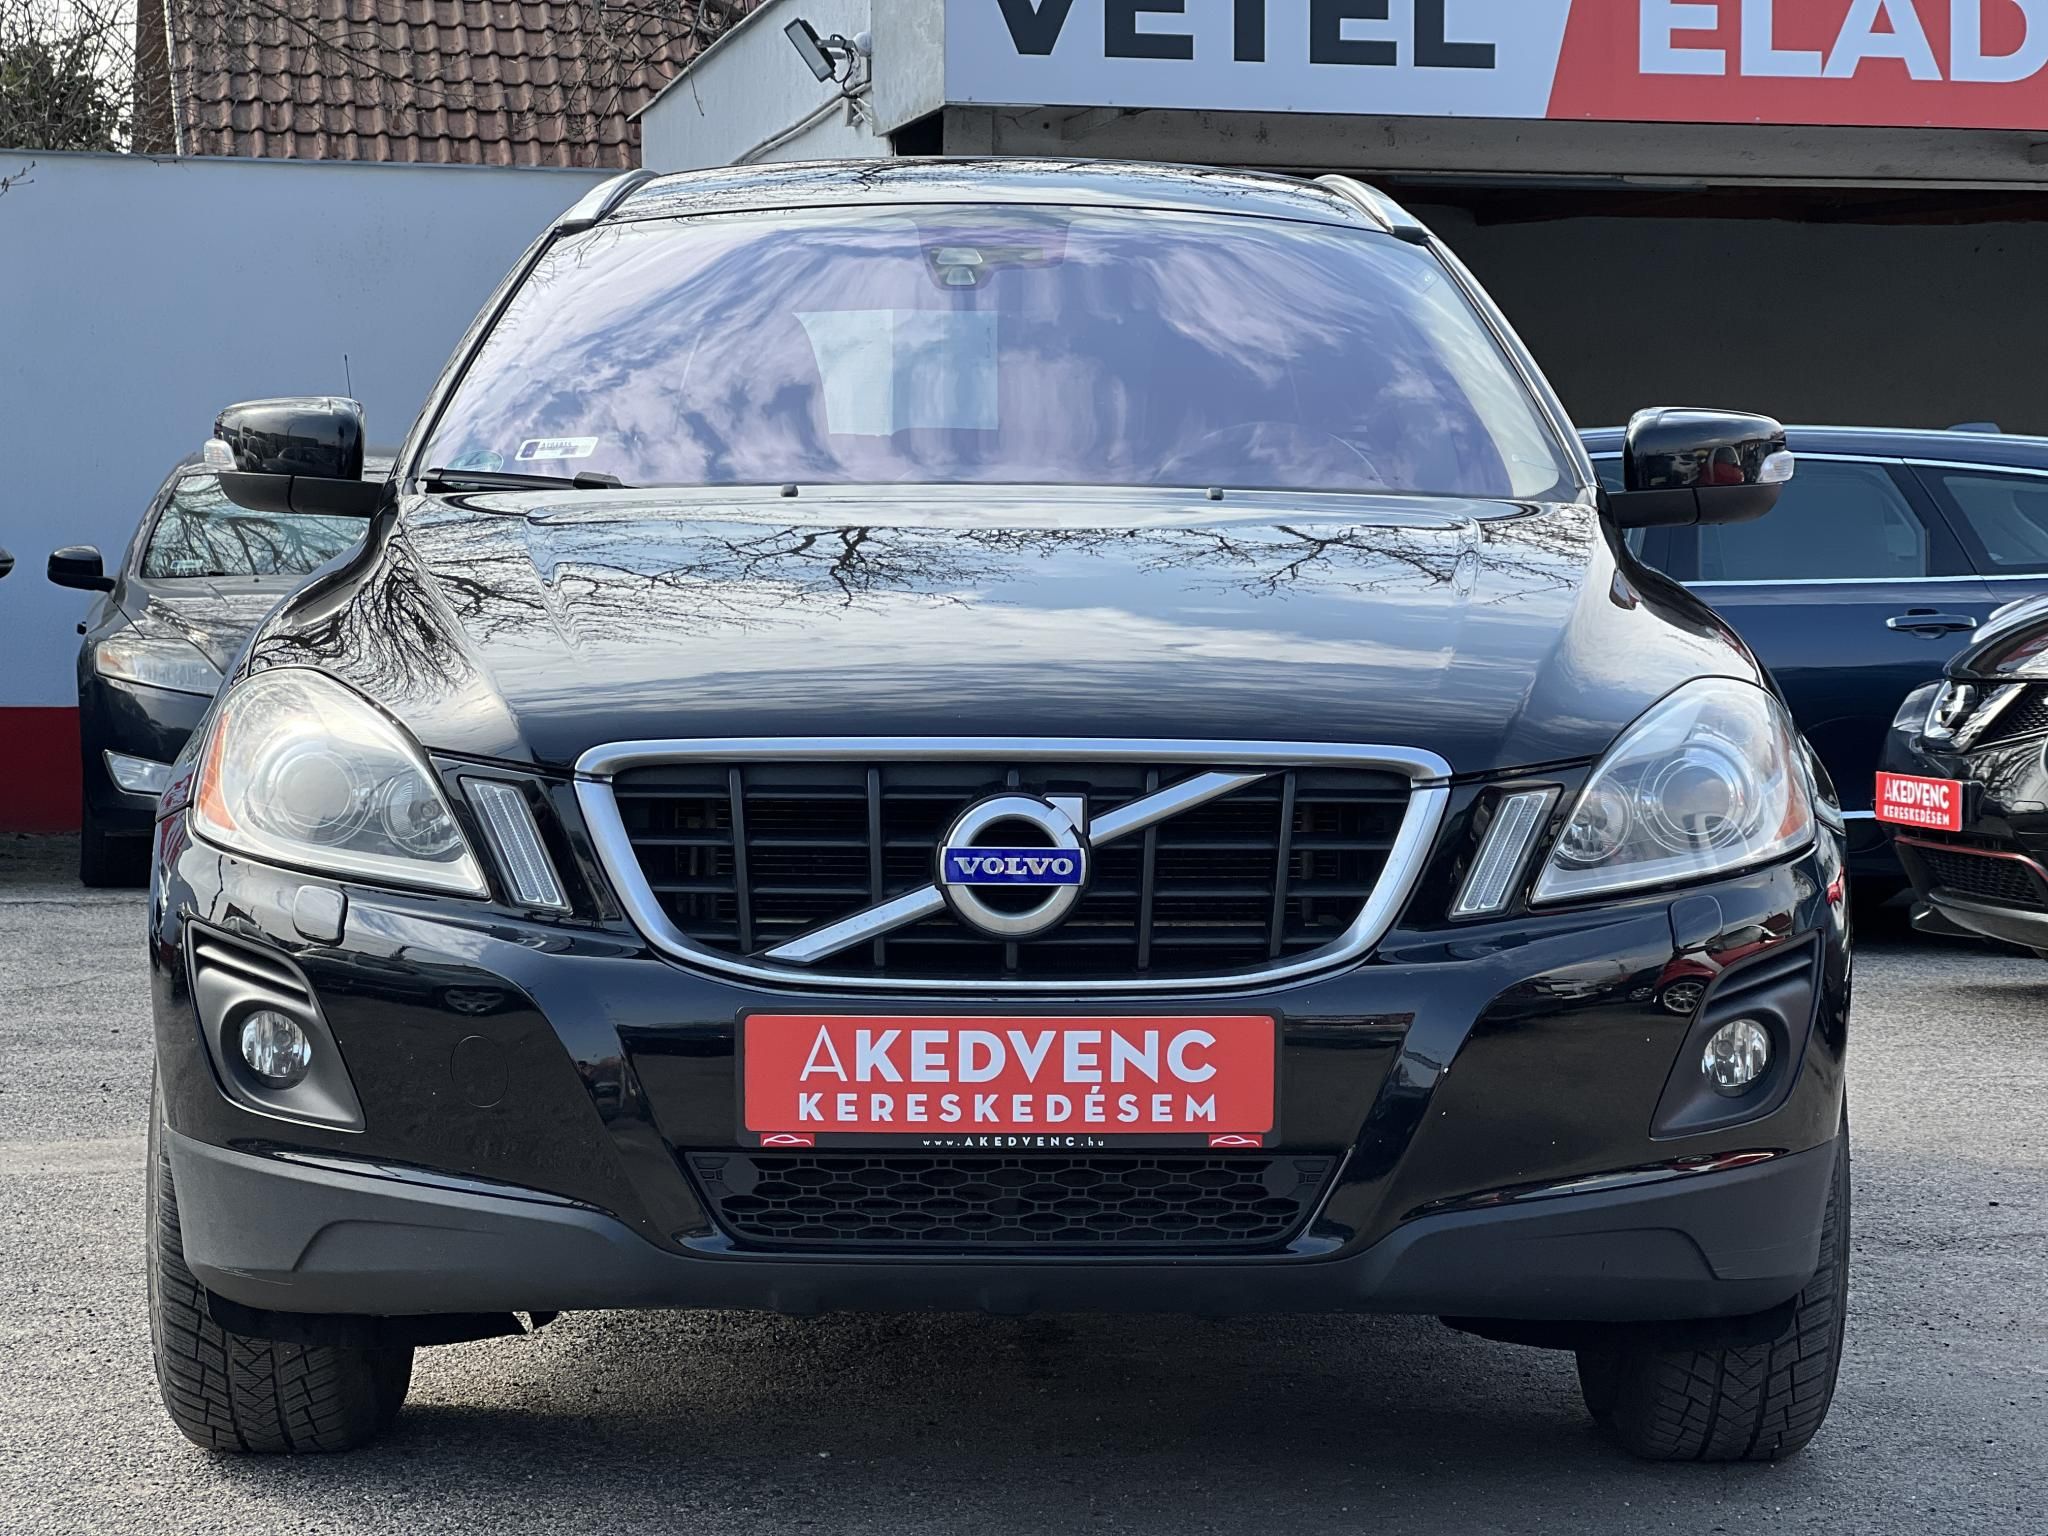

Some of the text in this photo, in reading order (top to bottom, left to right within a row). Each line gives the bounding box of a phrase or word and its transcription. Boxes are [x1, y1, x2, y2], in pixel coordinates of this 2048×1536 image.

[1884, 777, 1950, 810] AKEDVENC
[1883, 804, 1950, 826] KERESKEDÉSEM
[953, 857, 1074, 876] VOLVO
[799, 1024, 1217, 1084] AKEDVENC
[798, 1086, 1217, 1123] KERESKEDÉSEM
[922, 1136, 1104, 1147] www.AKEDVENC.hu
